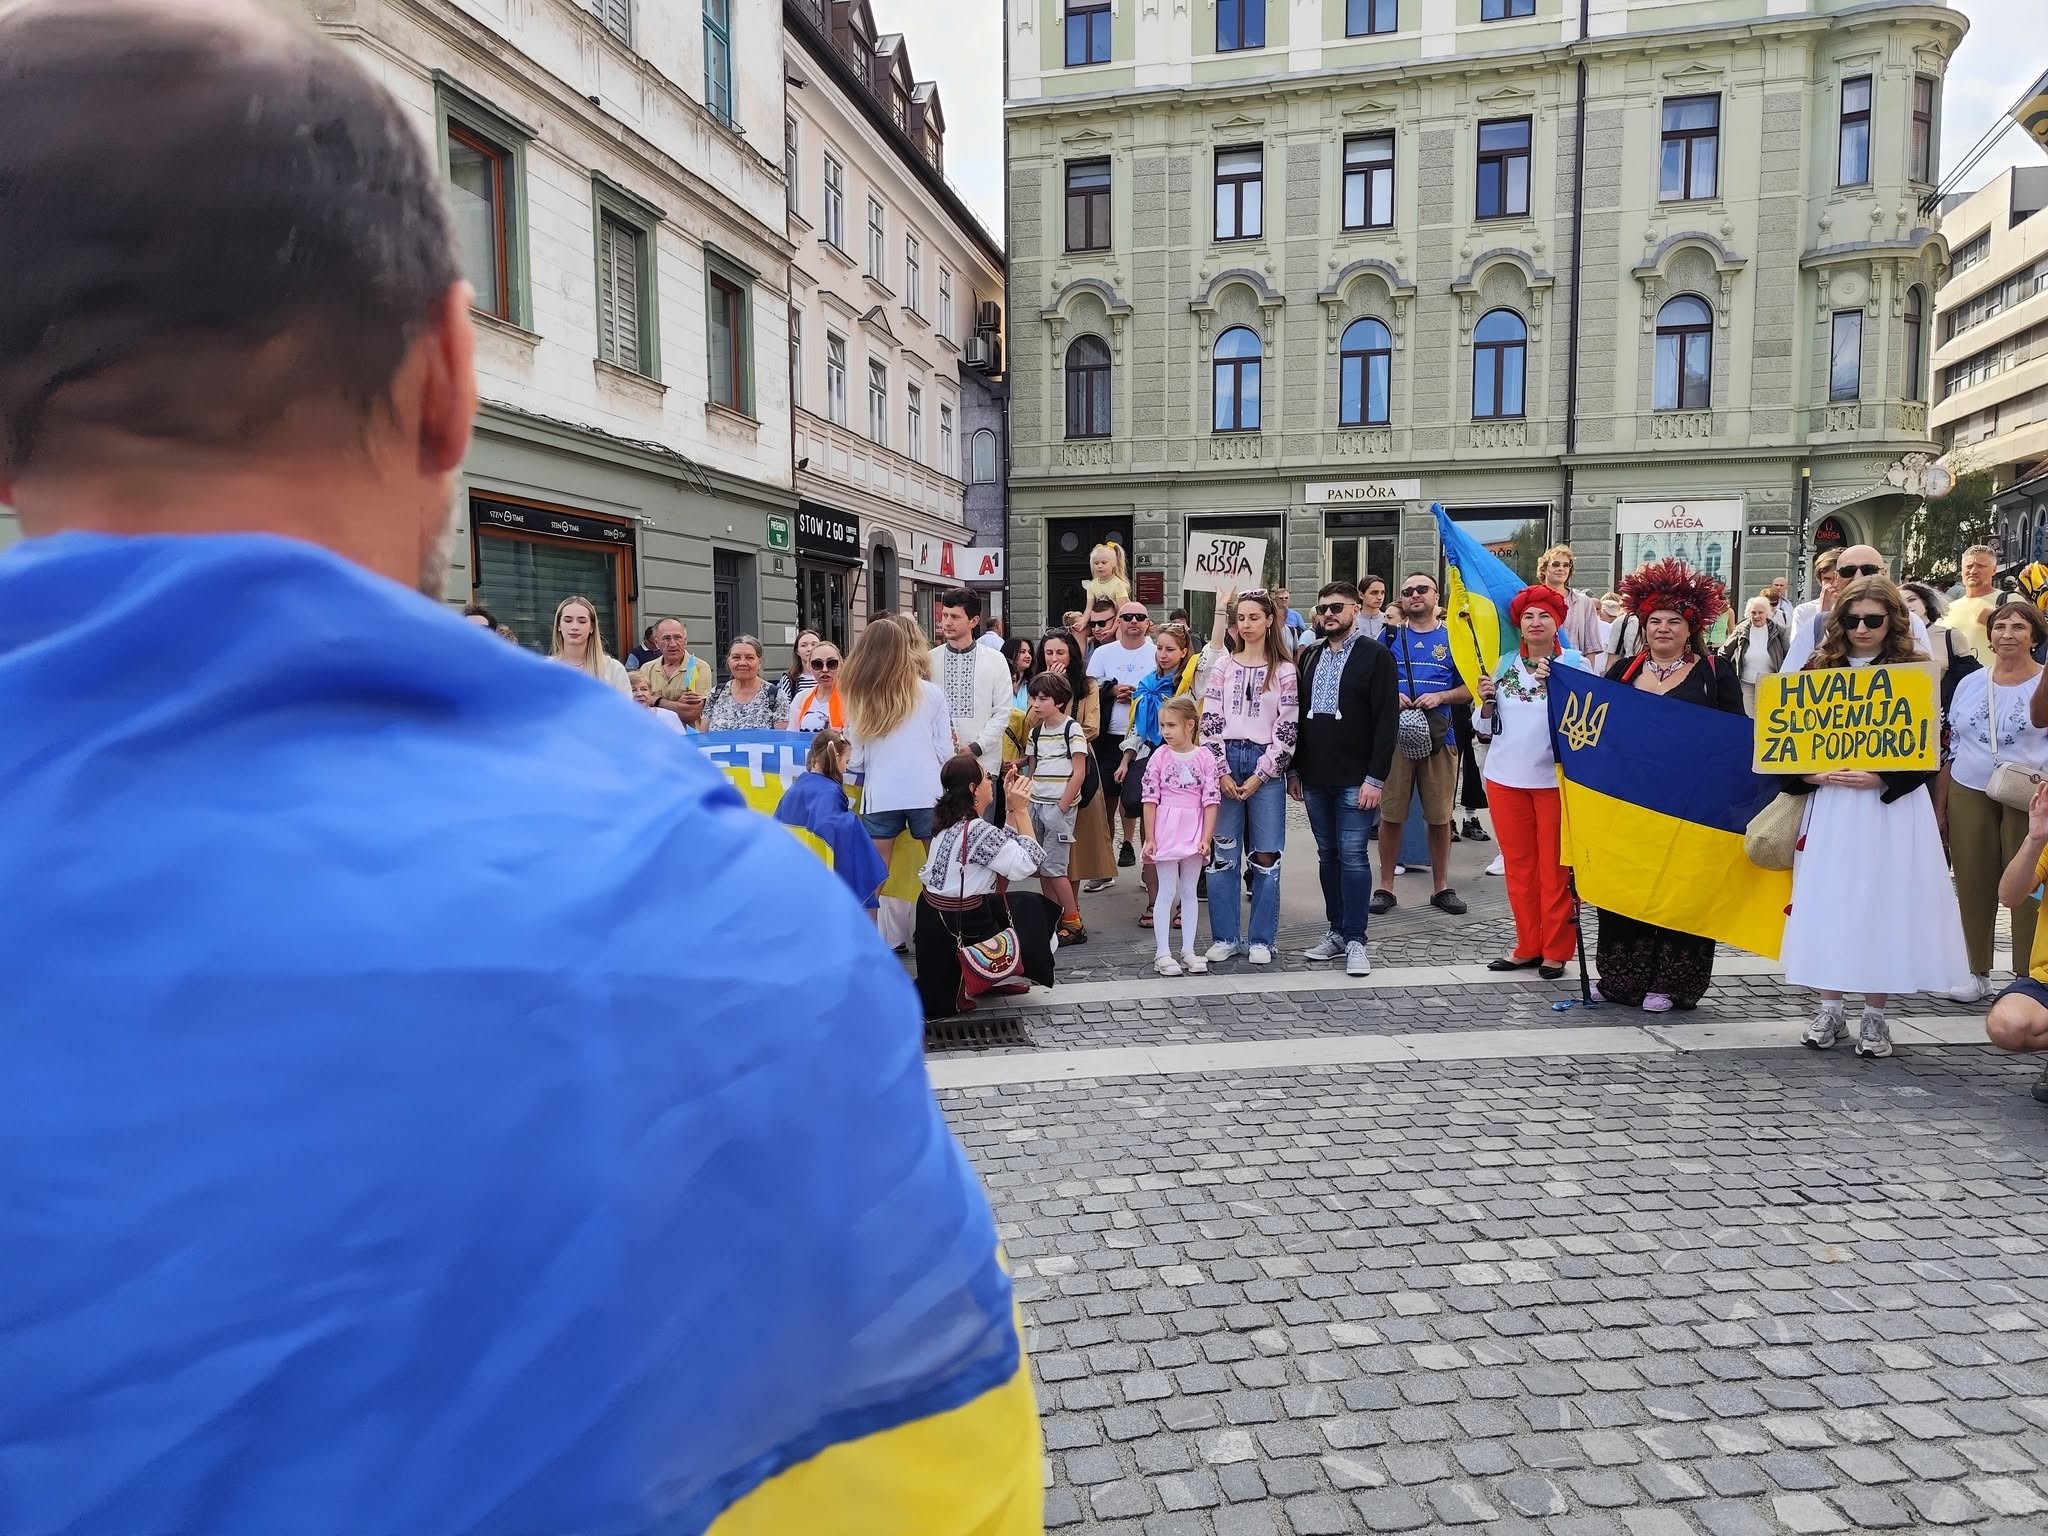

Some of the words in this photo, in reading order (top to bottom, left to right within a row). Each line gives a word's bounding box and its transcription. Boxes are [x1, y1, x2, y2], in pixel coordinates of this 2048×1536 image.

[489, 510, 504, 519] STEN
[1653, 518, 1704, 529] OMEGA
[800, 513, 824, 537] STOW
[826, 520, 832, 539] 2
[833, 522, 844, 541] GO
[1817, 530, 1841, 540] OMEGA
[1211, 540, 1246, 557] STOP
[979, 552, 999, 575] A1
[1196, 554, 1253, 576] RUSSIA
[1780, 668, 1893, 709] HVALA
[1767, 697, 1912, 734] SLOVENIJA
[1761, 736, 1798, 763] ZA
[1811, 718, 1928, 761] PODPORO!
